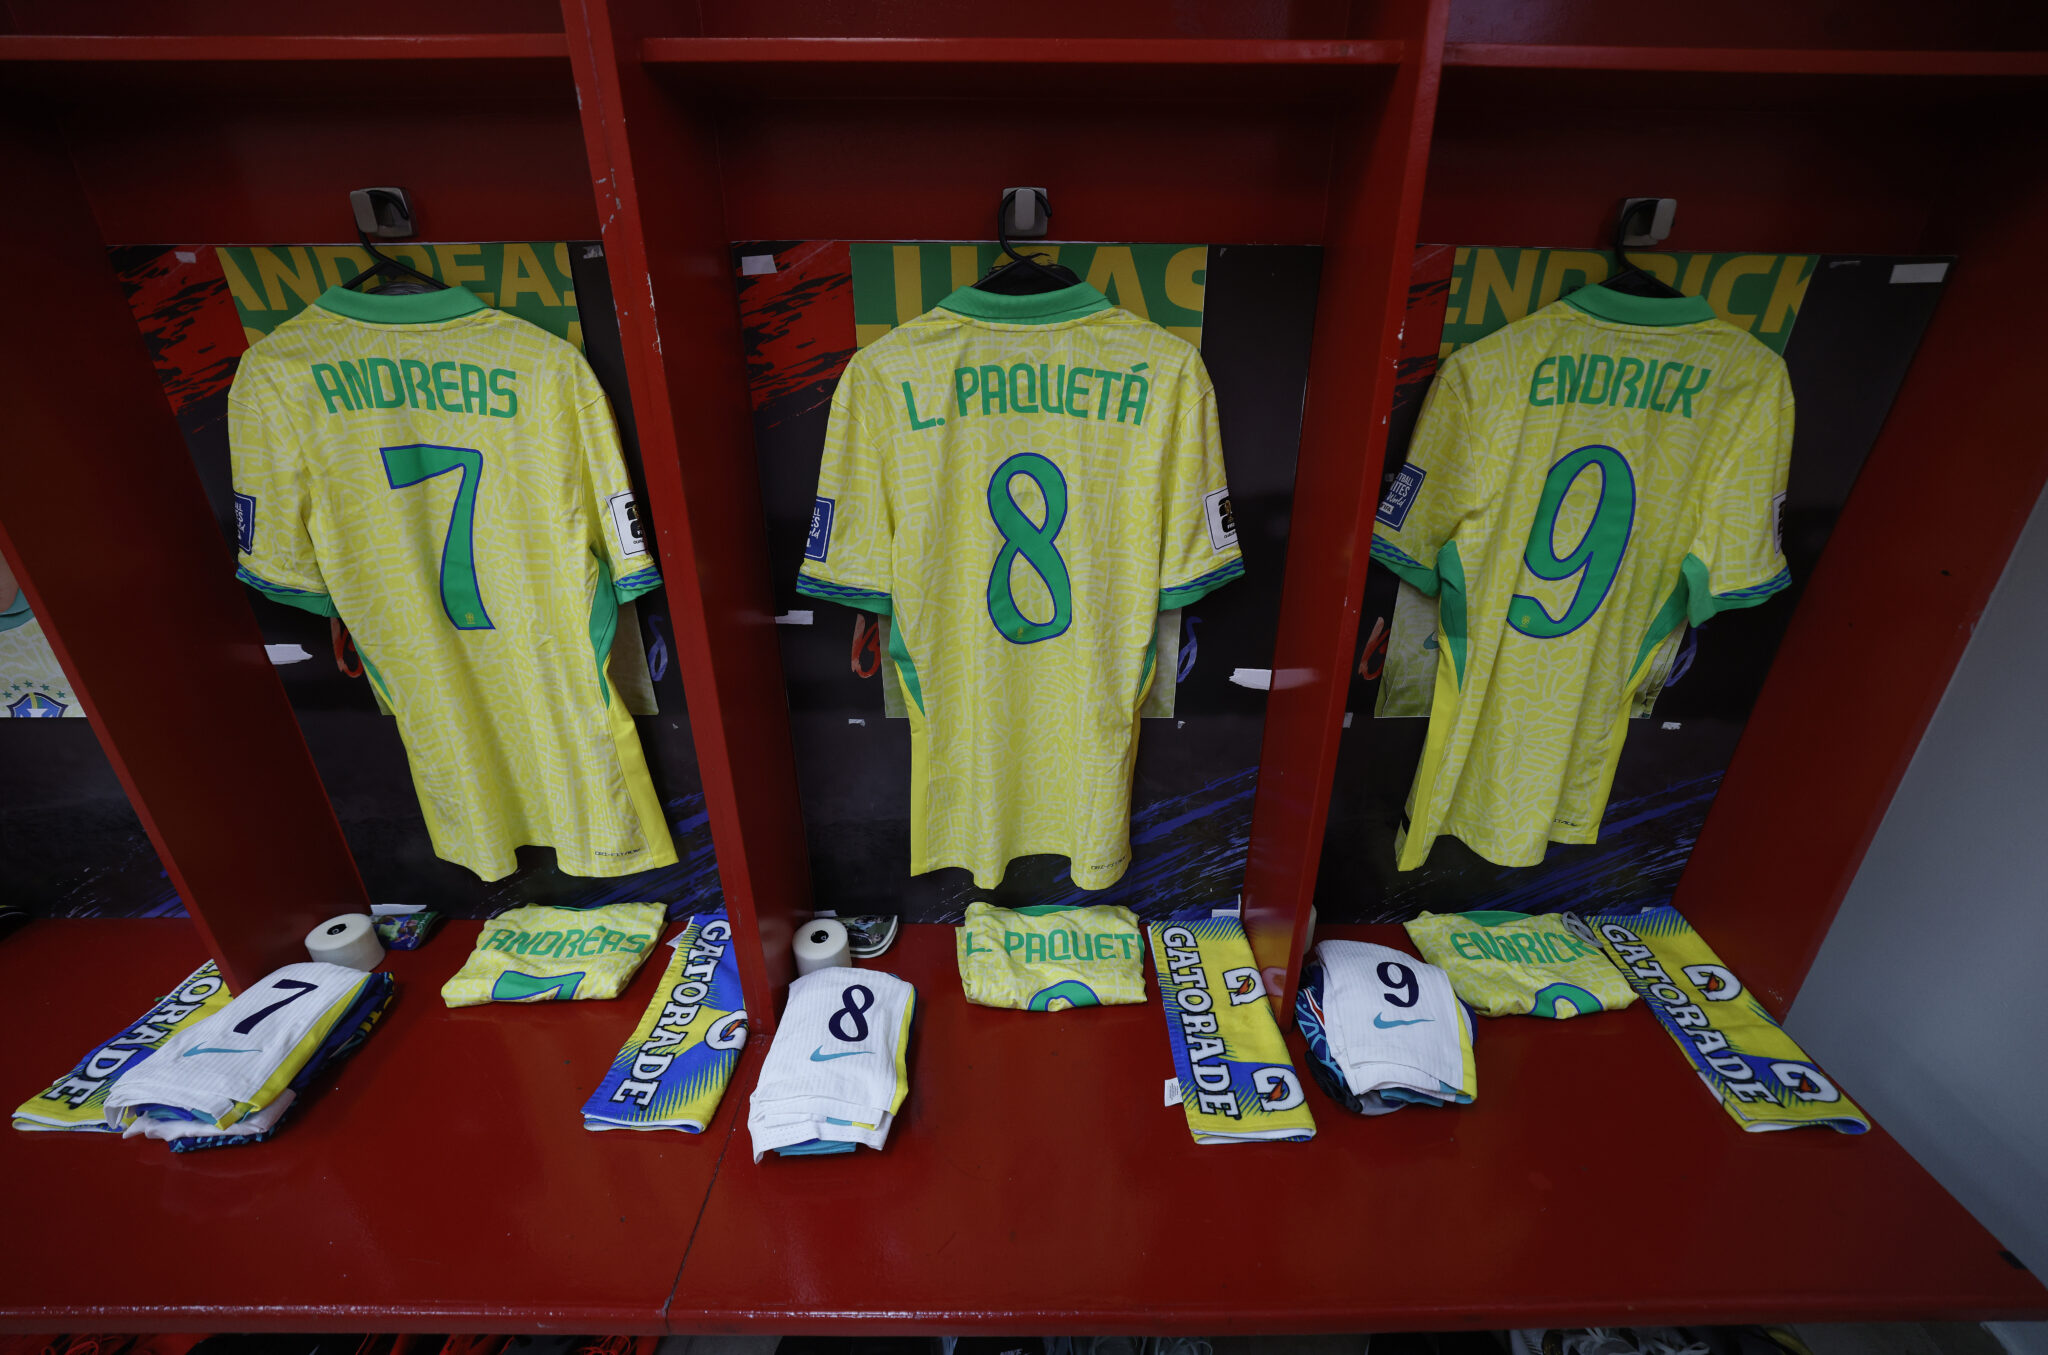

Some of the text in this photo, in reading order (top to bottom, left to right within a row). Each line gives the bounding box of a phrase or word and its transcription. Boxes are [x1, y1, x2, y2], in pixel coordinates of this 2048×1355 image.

[311, 357, 518, 419] ANDREAS
[902, 362, 1149, 431] L. PAQUETÁ
[1529, 354, 1711, 418] ENDRICK
[379, 443, 497, 631] 7
[986, 452, 1073, 645] 8
[1506, 444, 1636, 639] 9
[480, 925, 651, 958] ANDREAS
[966, 931, 993, 957] L.
[1450, 930, 1600, 965] ENDRICK
[233, 978, 319, 1035] 7
[609, 919, 732, 1111] GATORADE
[828, 984, 875, 1042] 8
[1376, 961, 1419, 1008] 9
[1600, 922, 1786, 1109] GATORADE
[41, 960, 224, 1110] ORADE
[1162, 926, 1242, 1120] GATORADE
